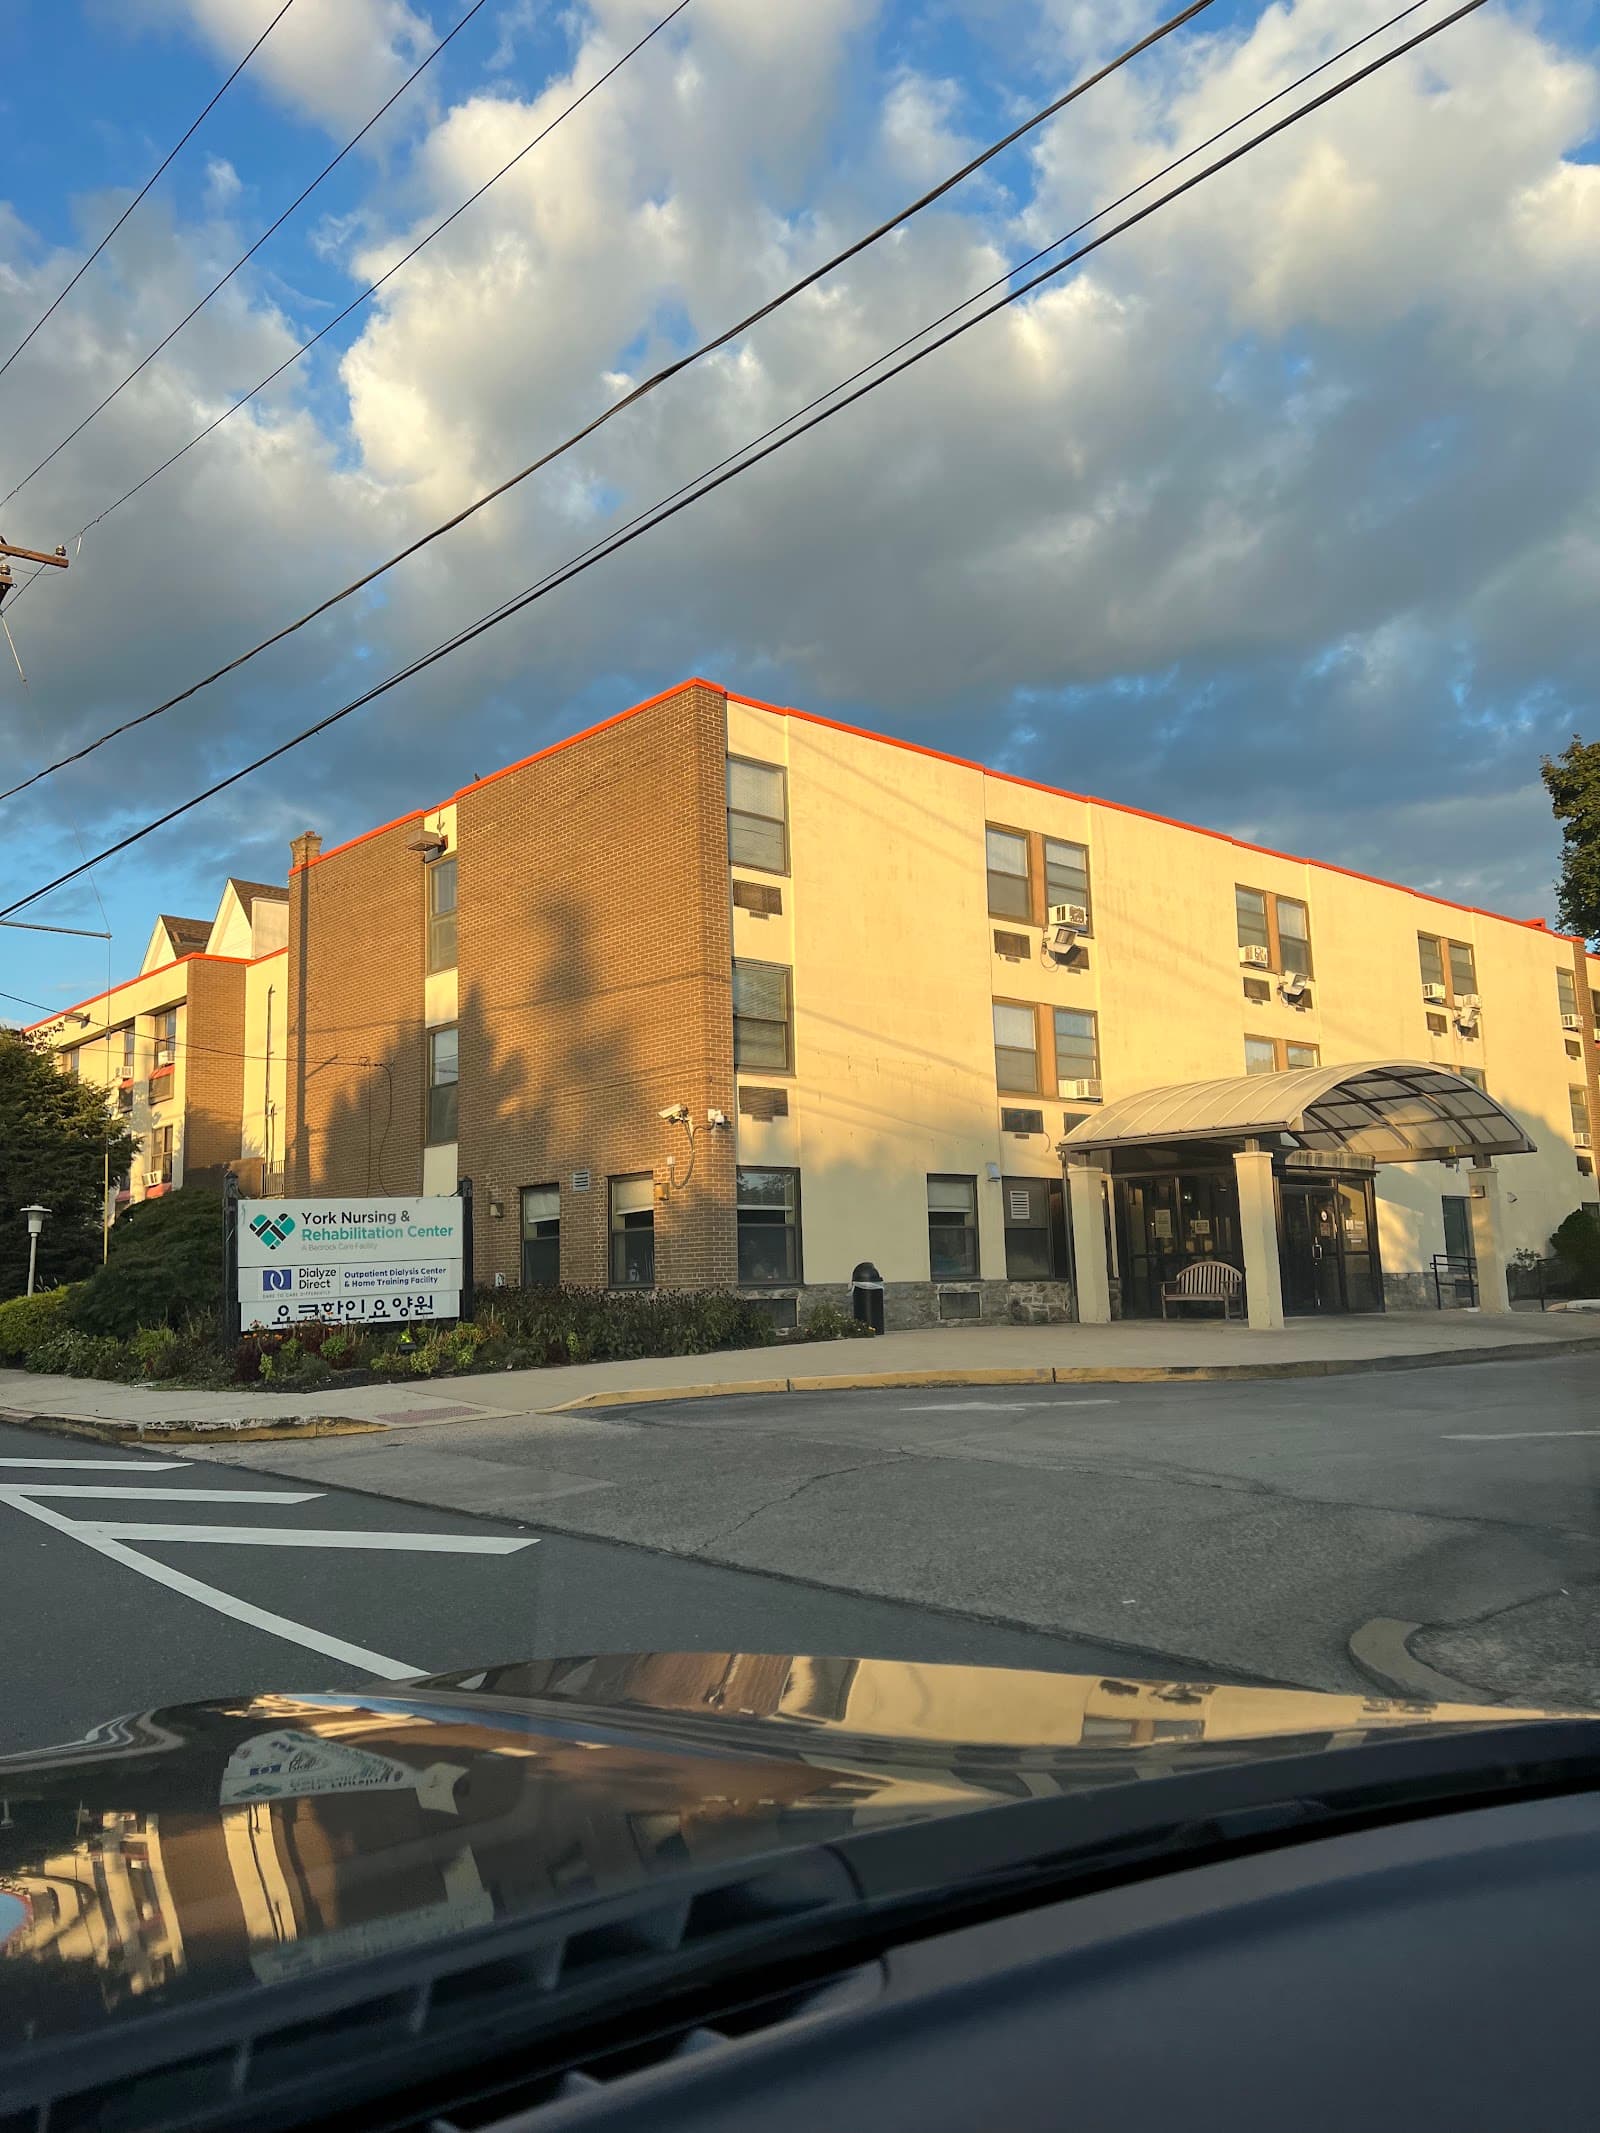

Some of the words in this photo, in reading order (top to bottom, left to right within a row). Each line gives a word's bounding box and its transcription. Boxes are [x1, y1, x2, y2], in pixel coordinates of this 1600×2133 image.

[302, 1212, 337, 1225] York
[342, 1211, 396, 1225] Nursing
[400, 1210, 410, 1222] &
[302, 1226, 403, 1241] Rehabilitation
[407, 1225, 453, 1238] Center
[299, 1267, 337, 1280] Dialyze
[344, 1269, 388, 1279] Outpatient
[389, 1267, 419, 1276] Dialysis
[421, 1267, 447, 1275] Center
[299, 1279, 331, 1290] Direct
[344, 1280, 350, 1288] &
[352, 1280, 376, 1288] Home
[377, 1277, 409, 1286] Training
[410, 1275, 438, 1284] Facility
